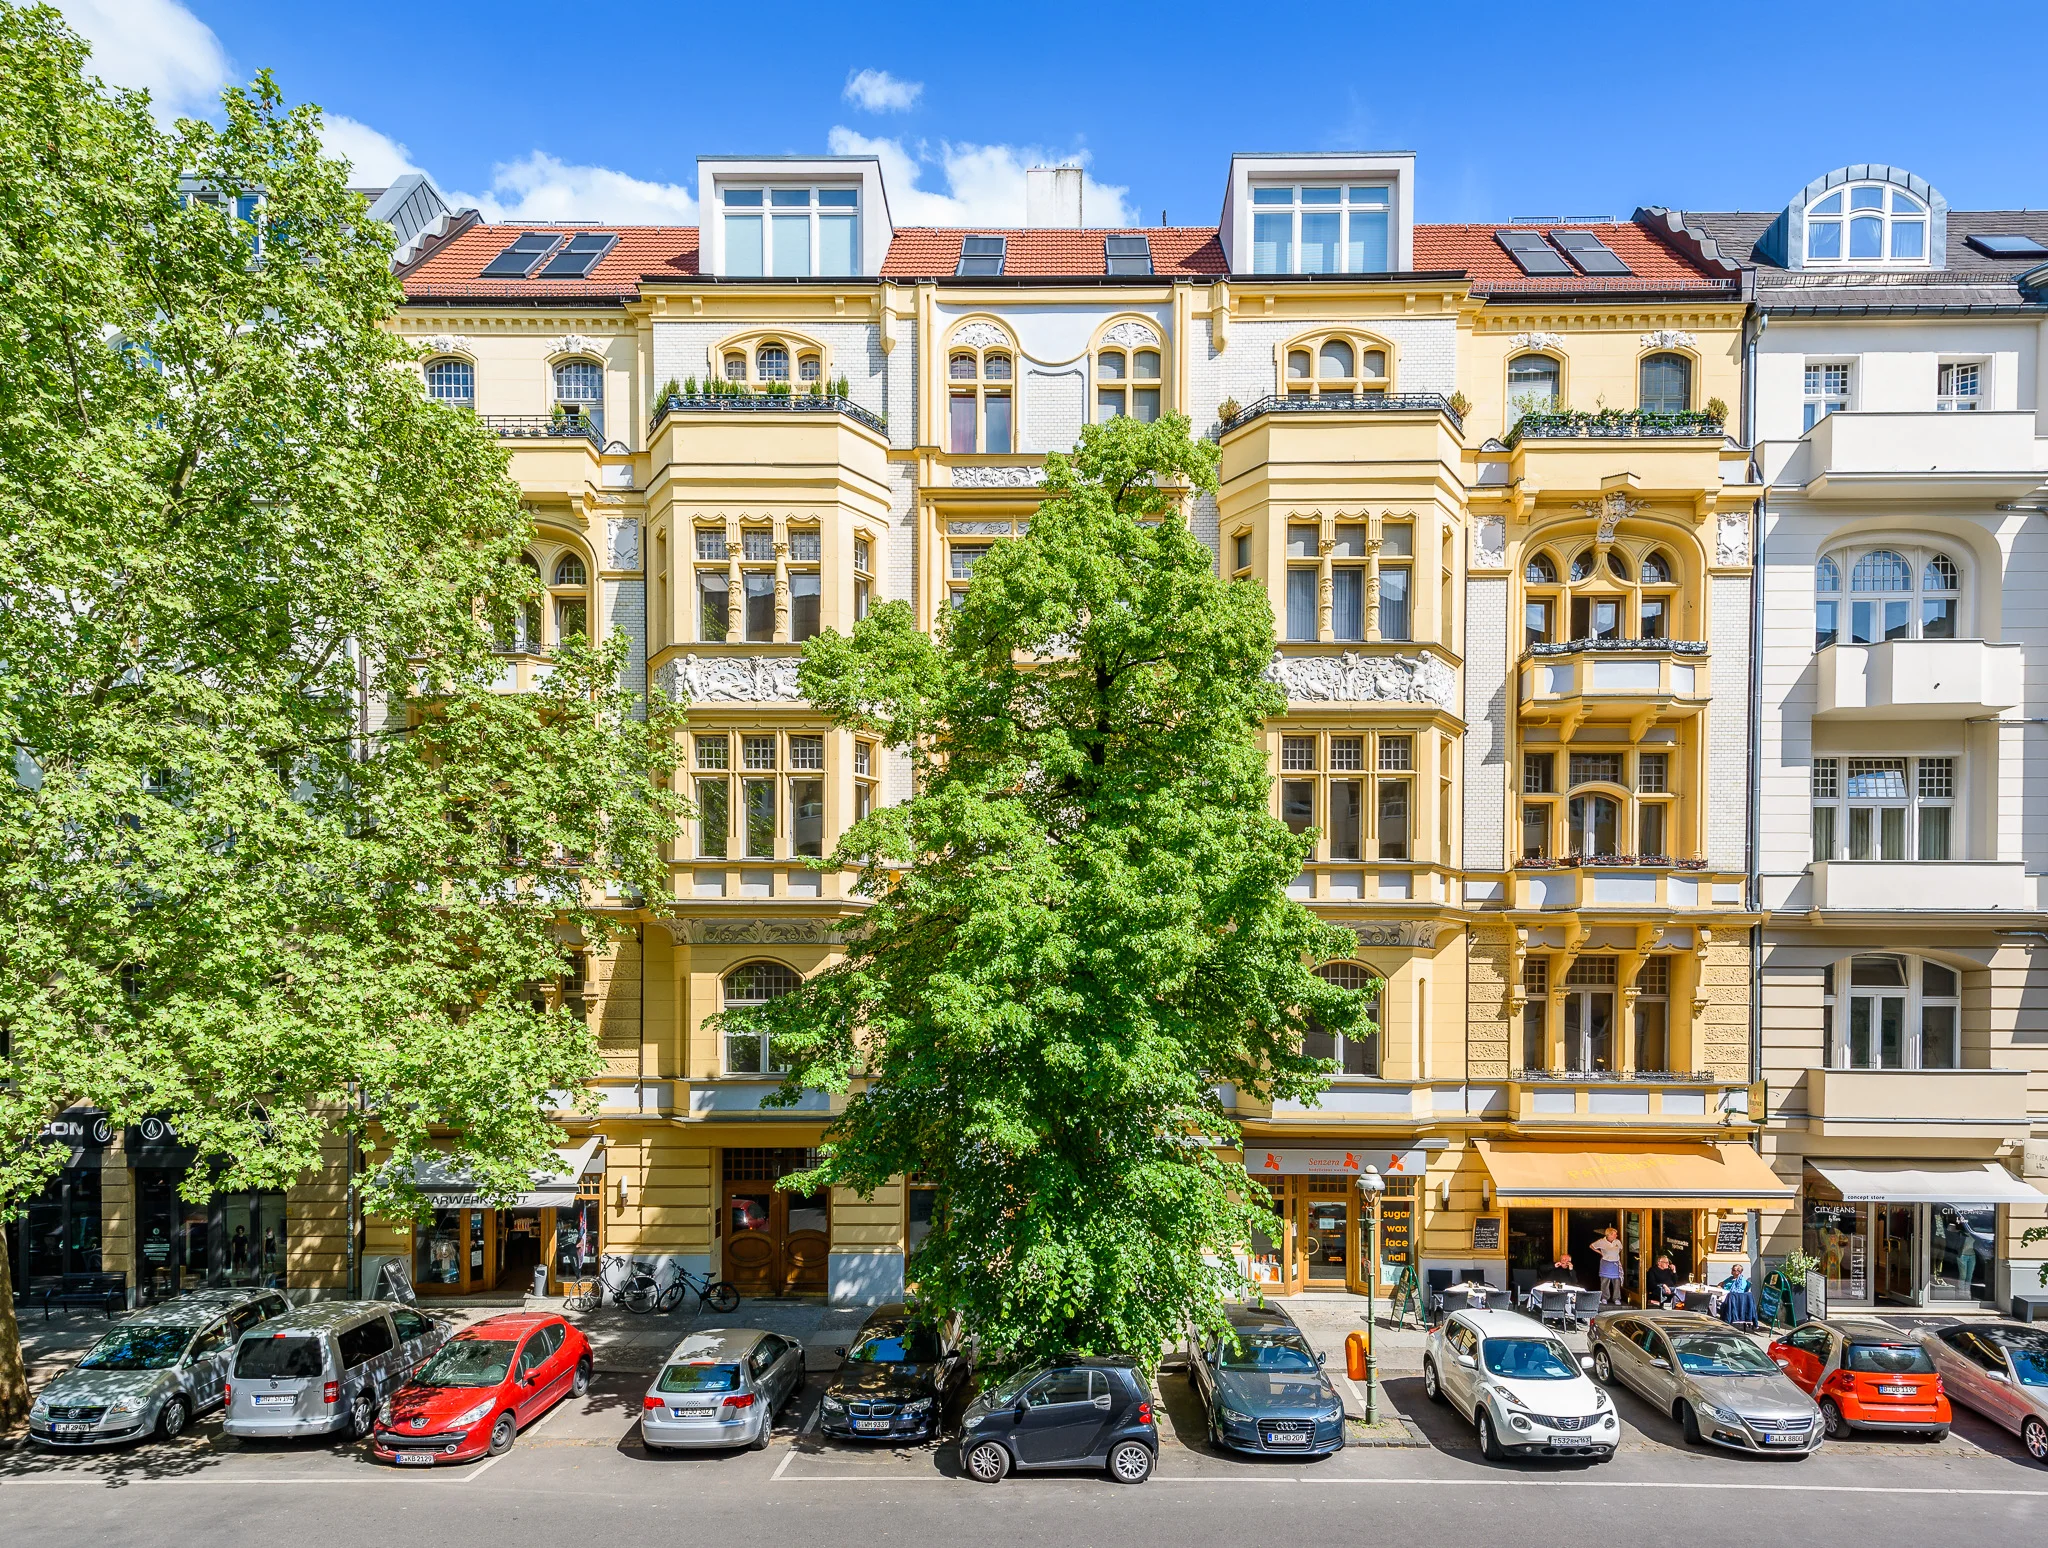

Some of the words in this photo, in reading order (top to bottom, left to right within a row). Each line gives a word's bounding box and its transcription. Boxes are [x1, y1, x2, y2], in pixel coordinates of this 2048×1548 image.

[2026, 1152, 2038, 1160] CITY
[1308, 1157, 1340, 1166] Senzera
[1833, 1206, 1856, 1214] JEANS
[1383, 1210, 1410, 1220] sugar
[1386, 1225, 1408, 1233] wax
[1385, 1237, 1409, 1247] face
[1388, 1252, 1406, 1262] nail
